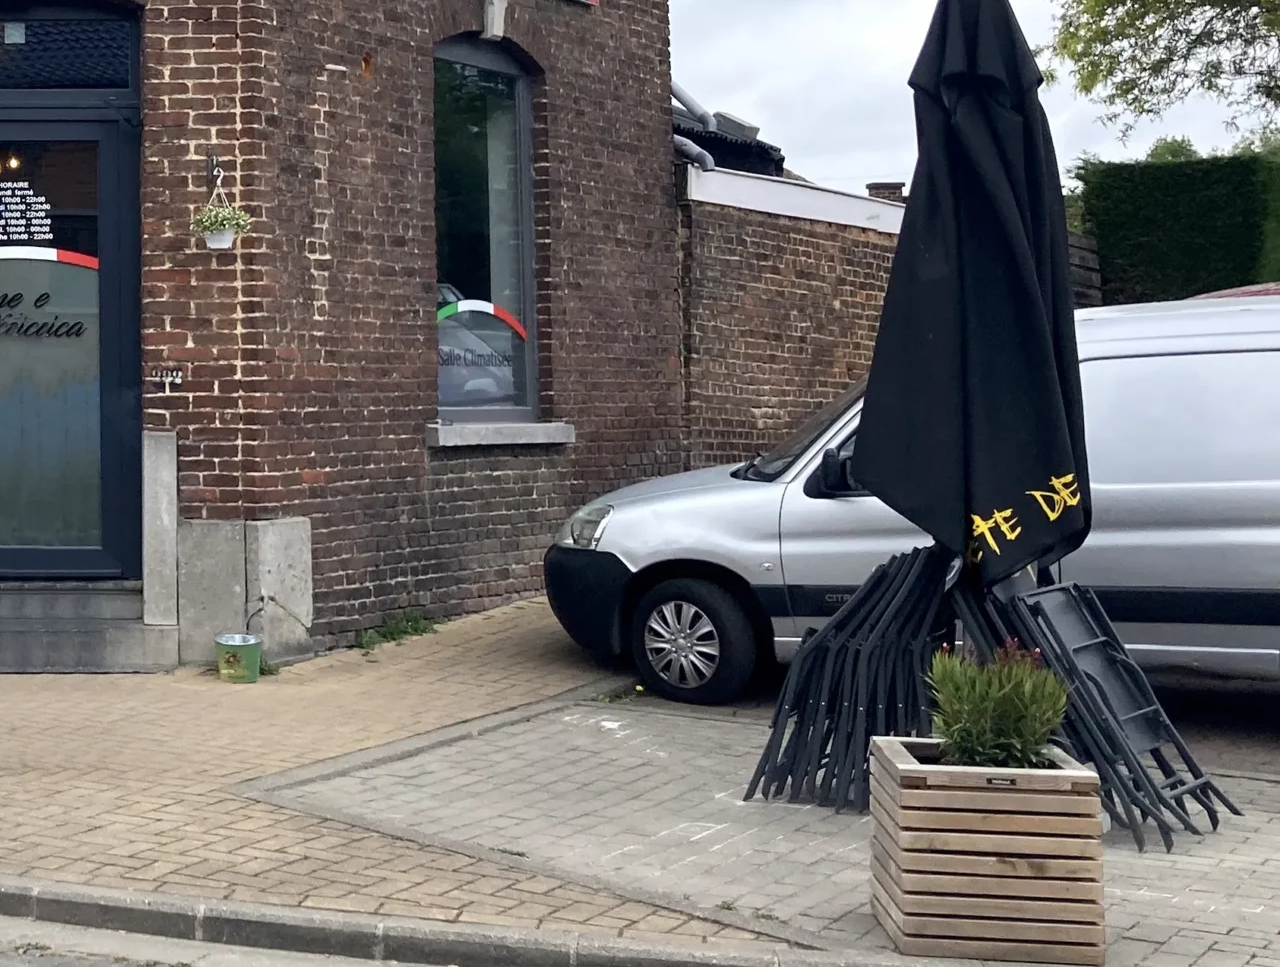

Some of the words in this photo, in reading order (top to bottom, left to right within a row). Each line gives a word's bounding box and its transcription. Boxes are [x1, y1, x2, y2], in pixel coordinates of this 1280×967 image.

[34, 291, 51, 309] e
[439, 348, 461, 366] Salle
[825, 593, 851, 602] CITR
